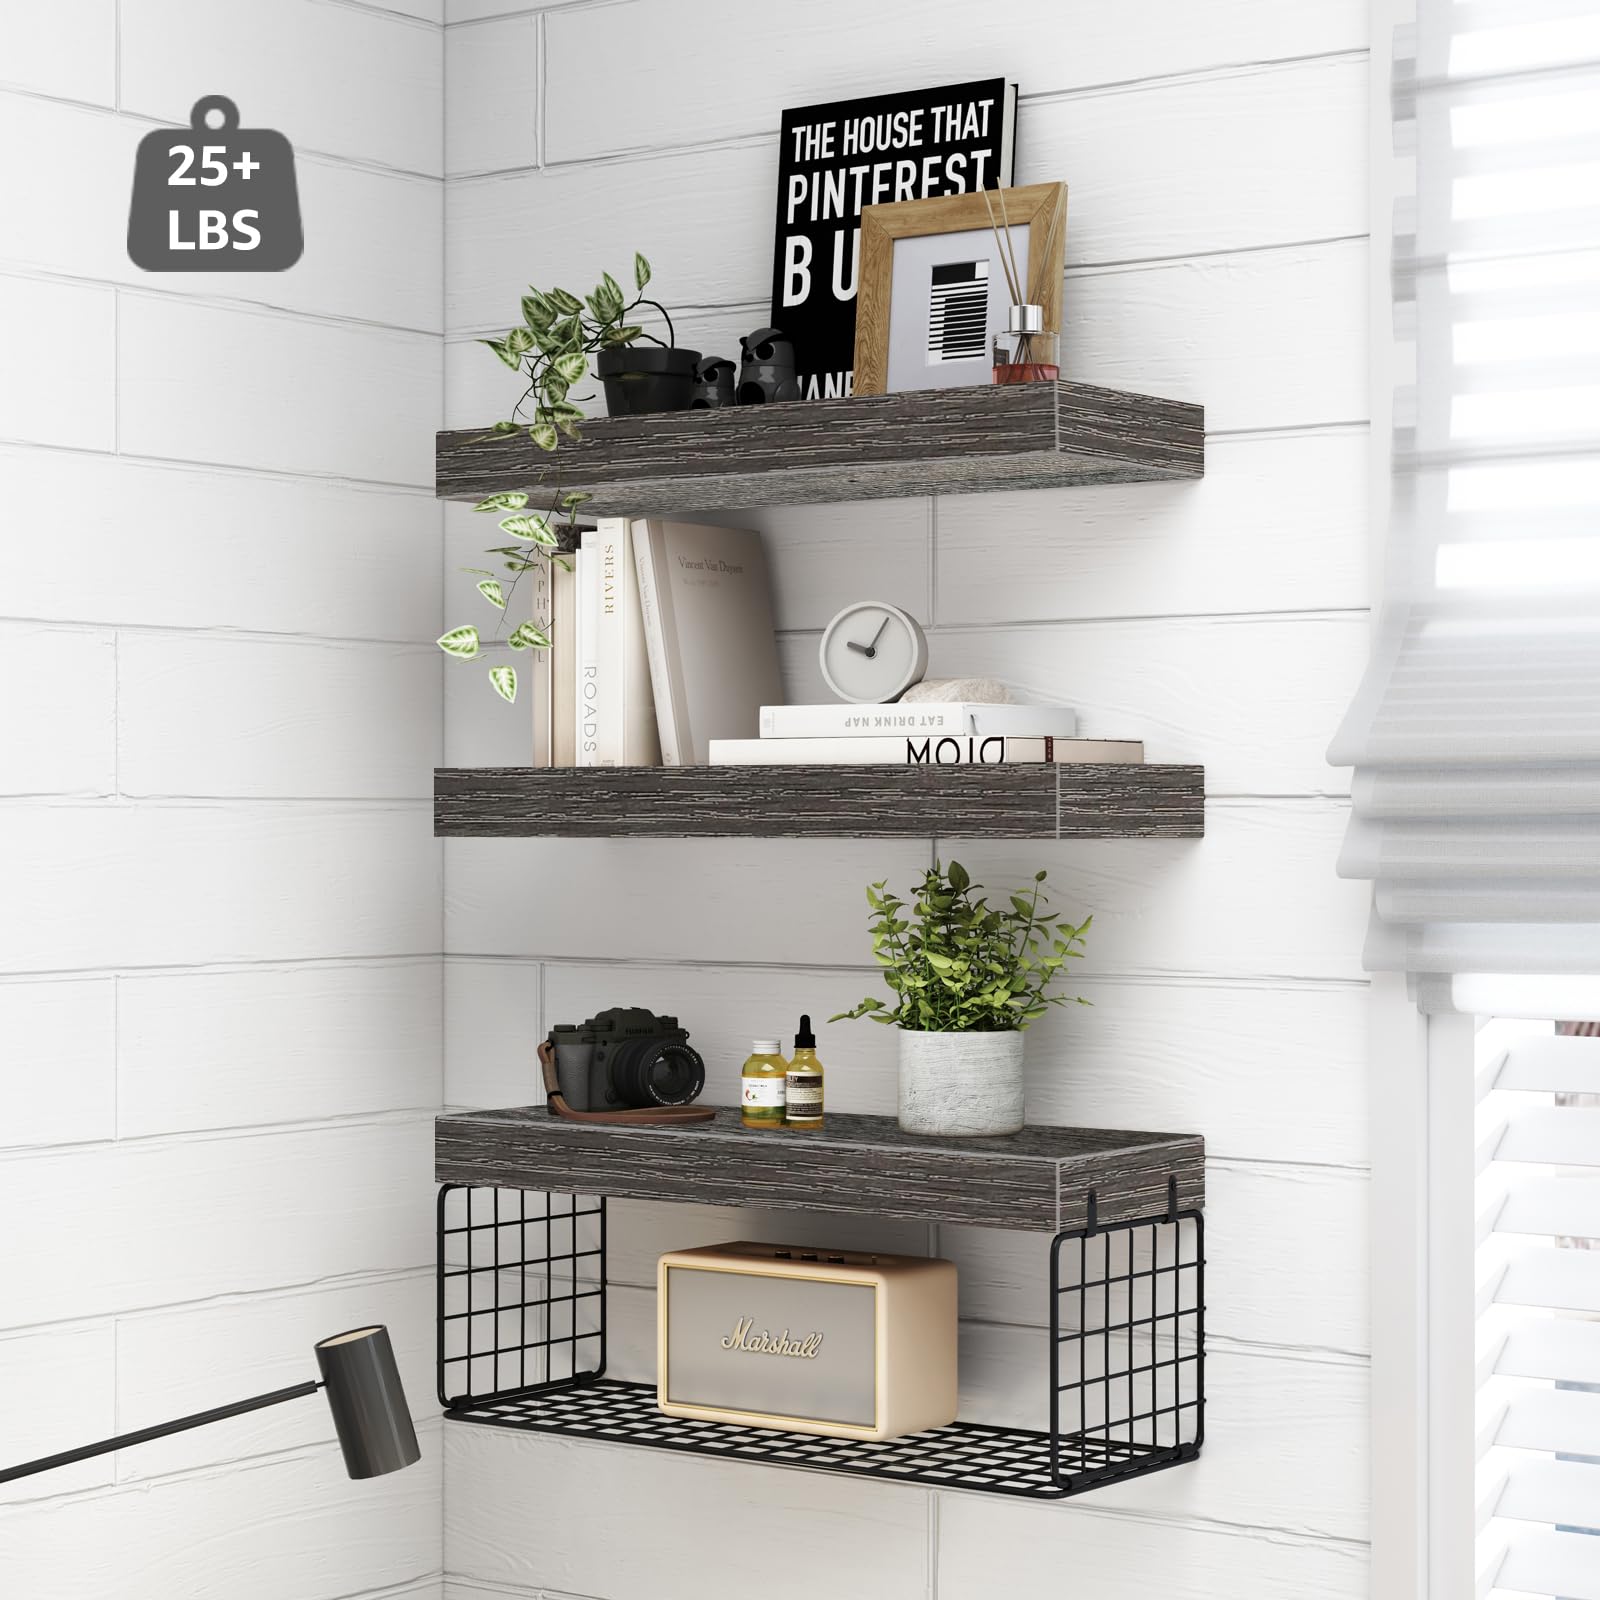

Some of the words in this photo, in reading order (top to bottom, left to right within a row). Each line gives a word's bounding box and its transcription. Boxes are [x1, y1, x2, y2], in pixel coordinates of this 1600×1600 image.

[792, 121, 836, 162] THE
[843, 109, 924, 156] HOUSE
[931, 99, 994, 143] THAT
[787, 149, 992, 224] PINTEREST
[536, 545, 547, 663] RAPHAL
[604, 544, 614, 614] RIVERS
[584, 666, 597, 752] ROADS
[845, 717, 869, 727] NAP
[874, 716, 915, 727] DRINK
[920, 715, 944, 726] EAT
[720, 1315, 824, 1359] Marshall
